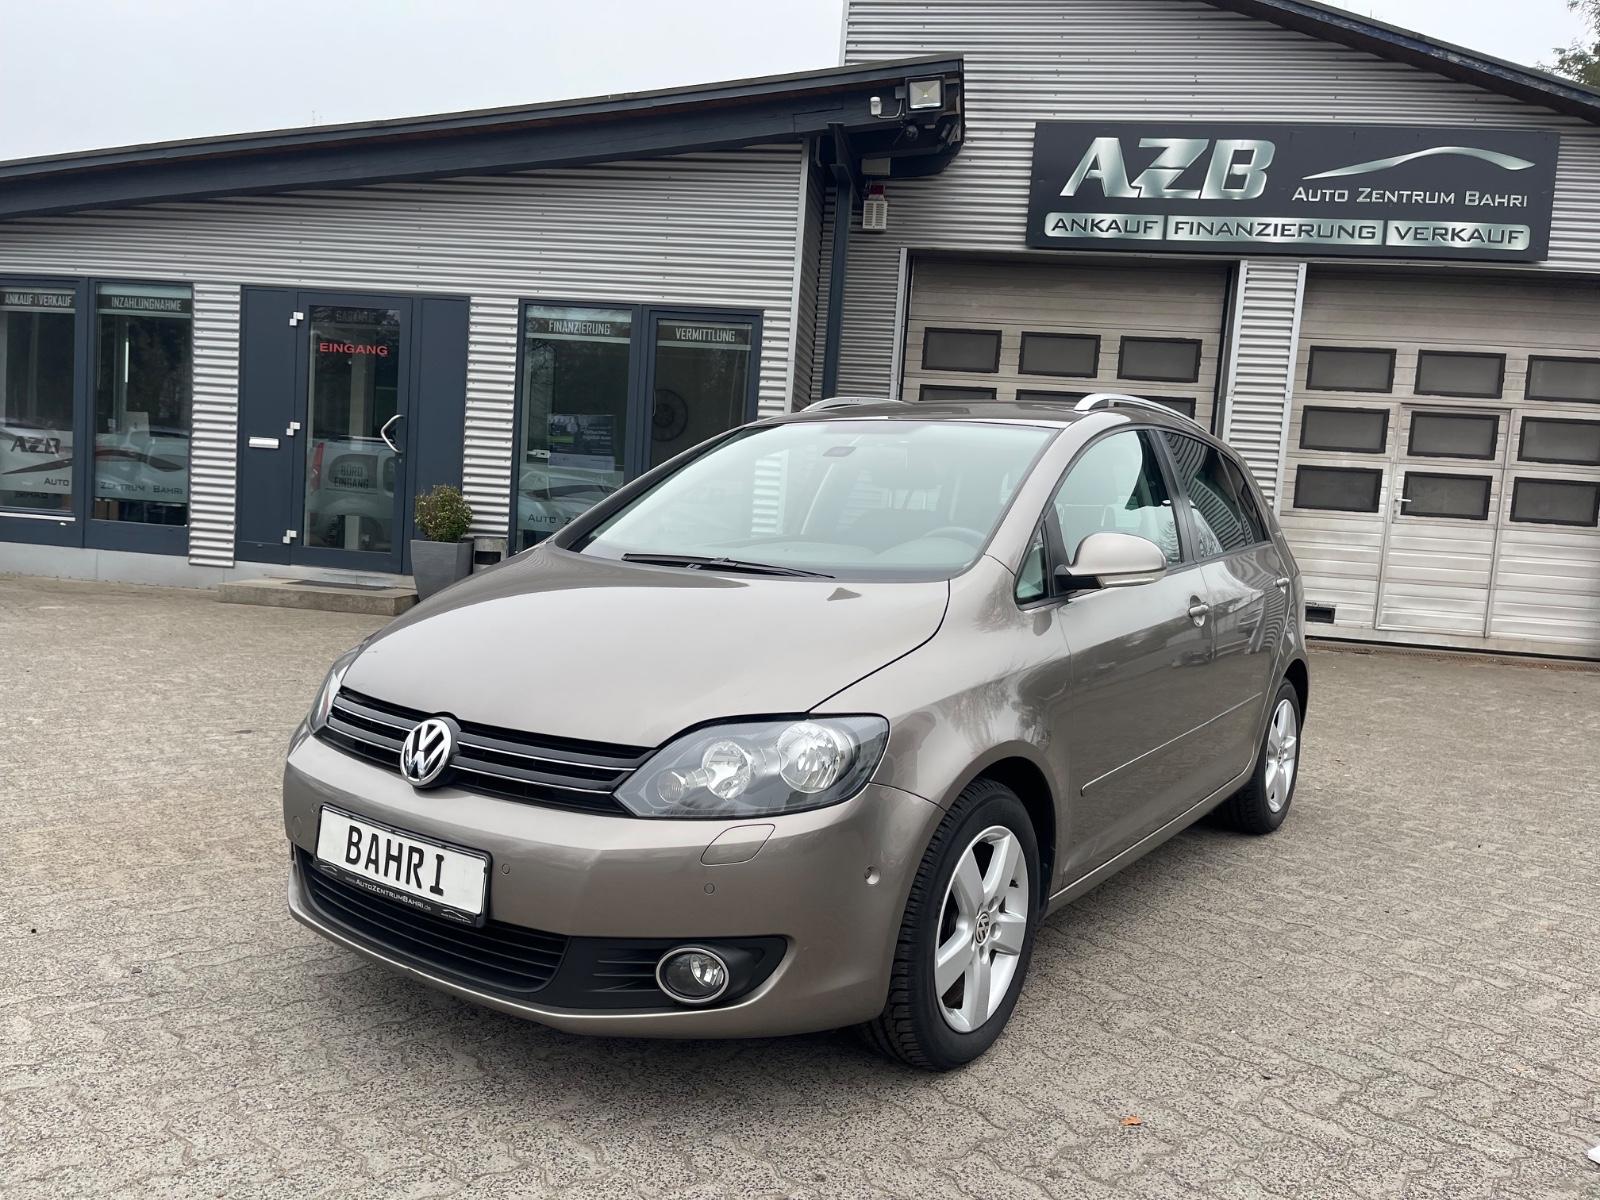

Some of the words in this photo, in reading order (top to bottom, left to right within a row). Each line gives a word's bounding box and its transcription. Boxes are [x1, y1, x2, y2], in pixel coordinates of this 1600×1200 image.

[1059, 136, 1276, 200] AZB
[1051, 216, 1159, 236] ANKAUF
[1173, 220, 1378, 241] FINANZIERUNG
[1394, 225, 1525, 246] VERKAUF
[5, 293, 33, 305] ANKAUF
[38, 295, 72, 307] VERKAUF
[111, 296, 182, 311] INZAHLUNGNAHME
[548, 319, 611, 335] FINANZIERUNG
[675, 327, 736, 342] VERMITTLUNG
[319, 342, 389, 356] EINGANG
[100, 481, 146, 492] ZETRUM
[345, 824, 445, 897] BAHRI
